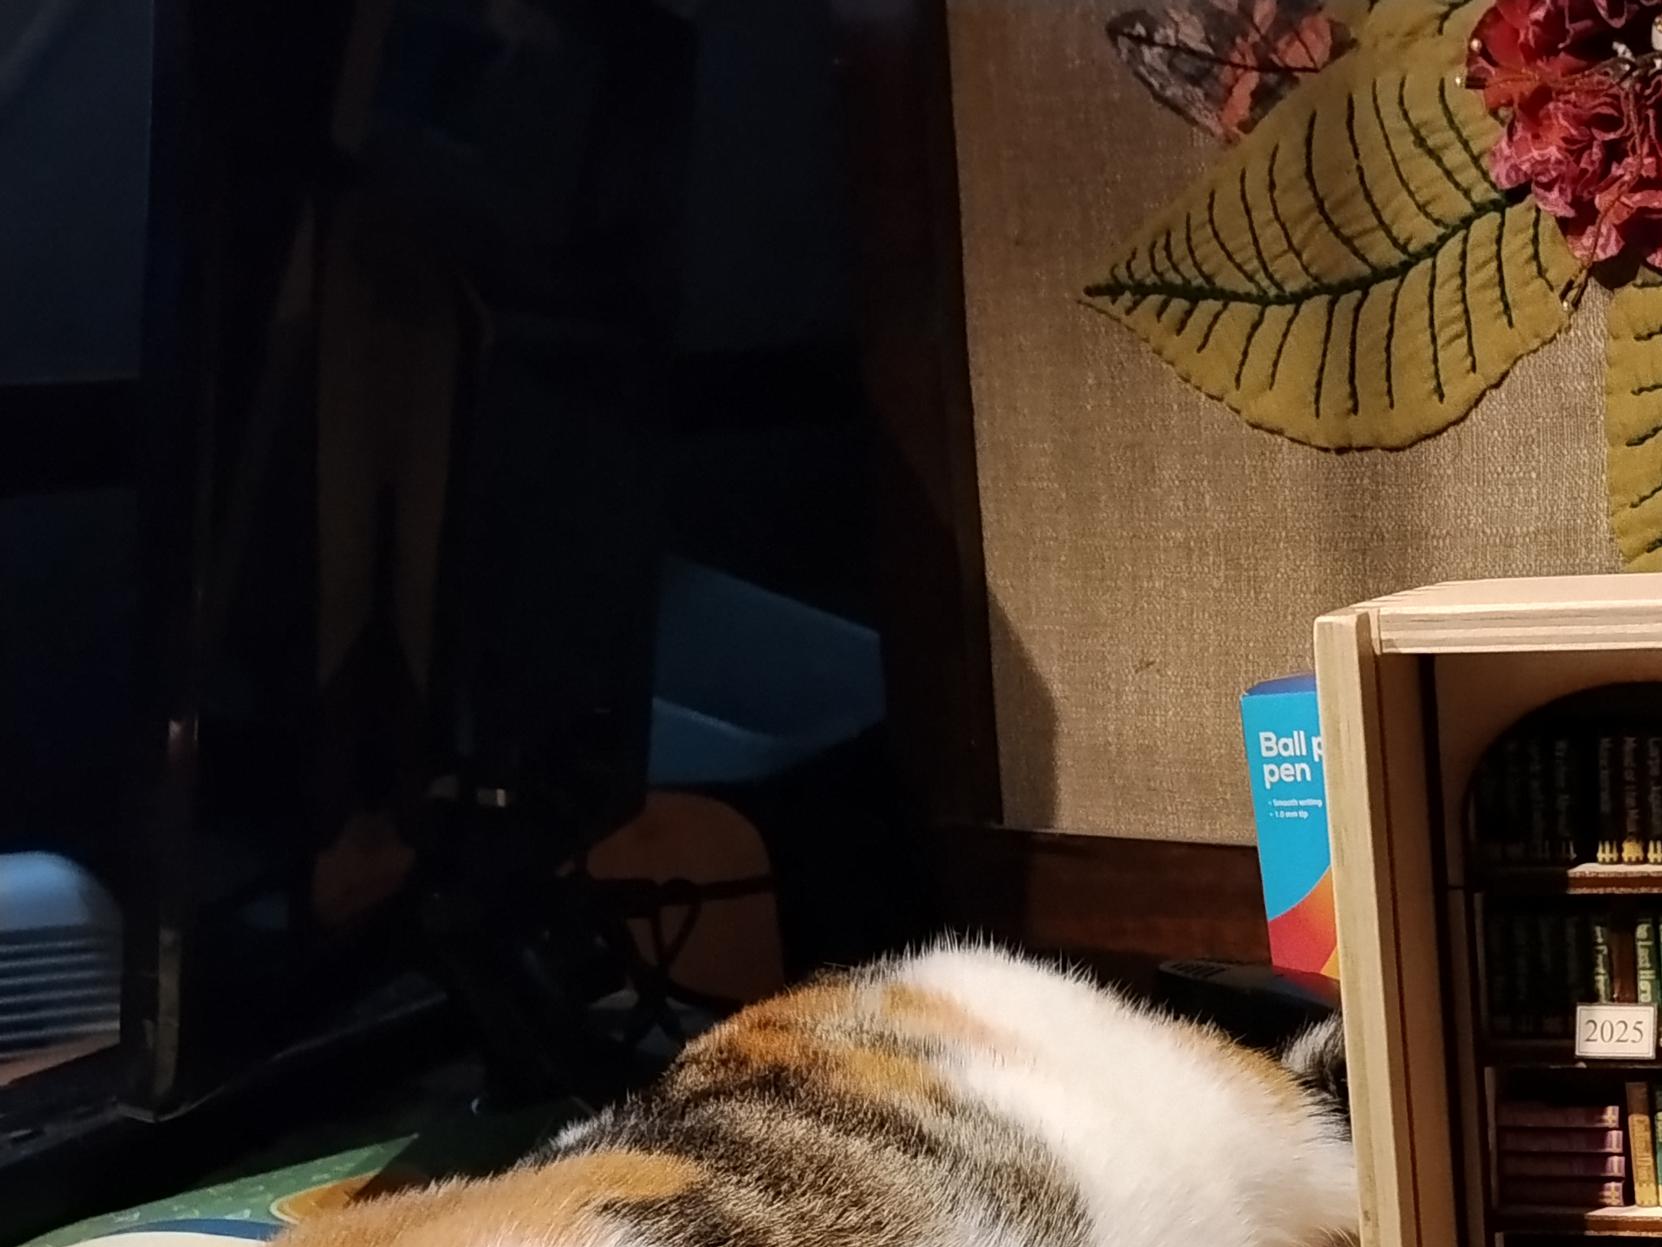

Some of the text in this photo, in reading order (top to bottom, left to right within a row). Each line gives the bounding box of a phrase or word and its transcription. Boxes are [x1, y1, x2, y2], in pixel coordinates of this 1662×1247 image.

[1258, 730, 1307, 757] Ball
[1263, 763, 1311, 790] pen
[1585, 1019, 1643, 1044] 2025
